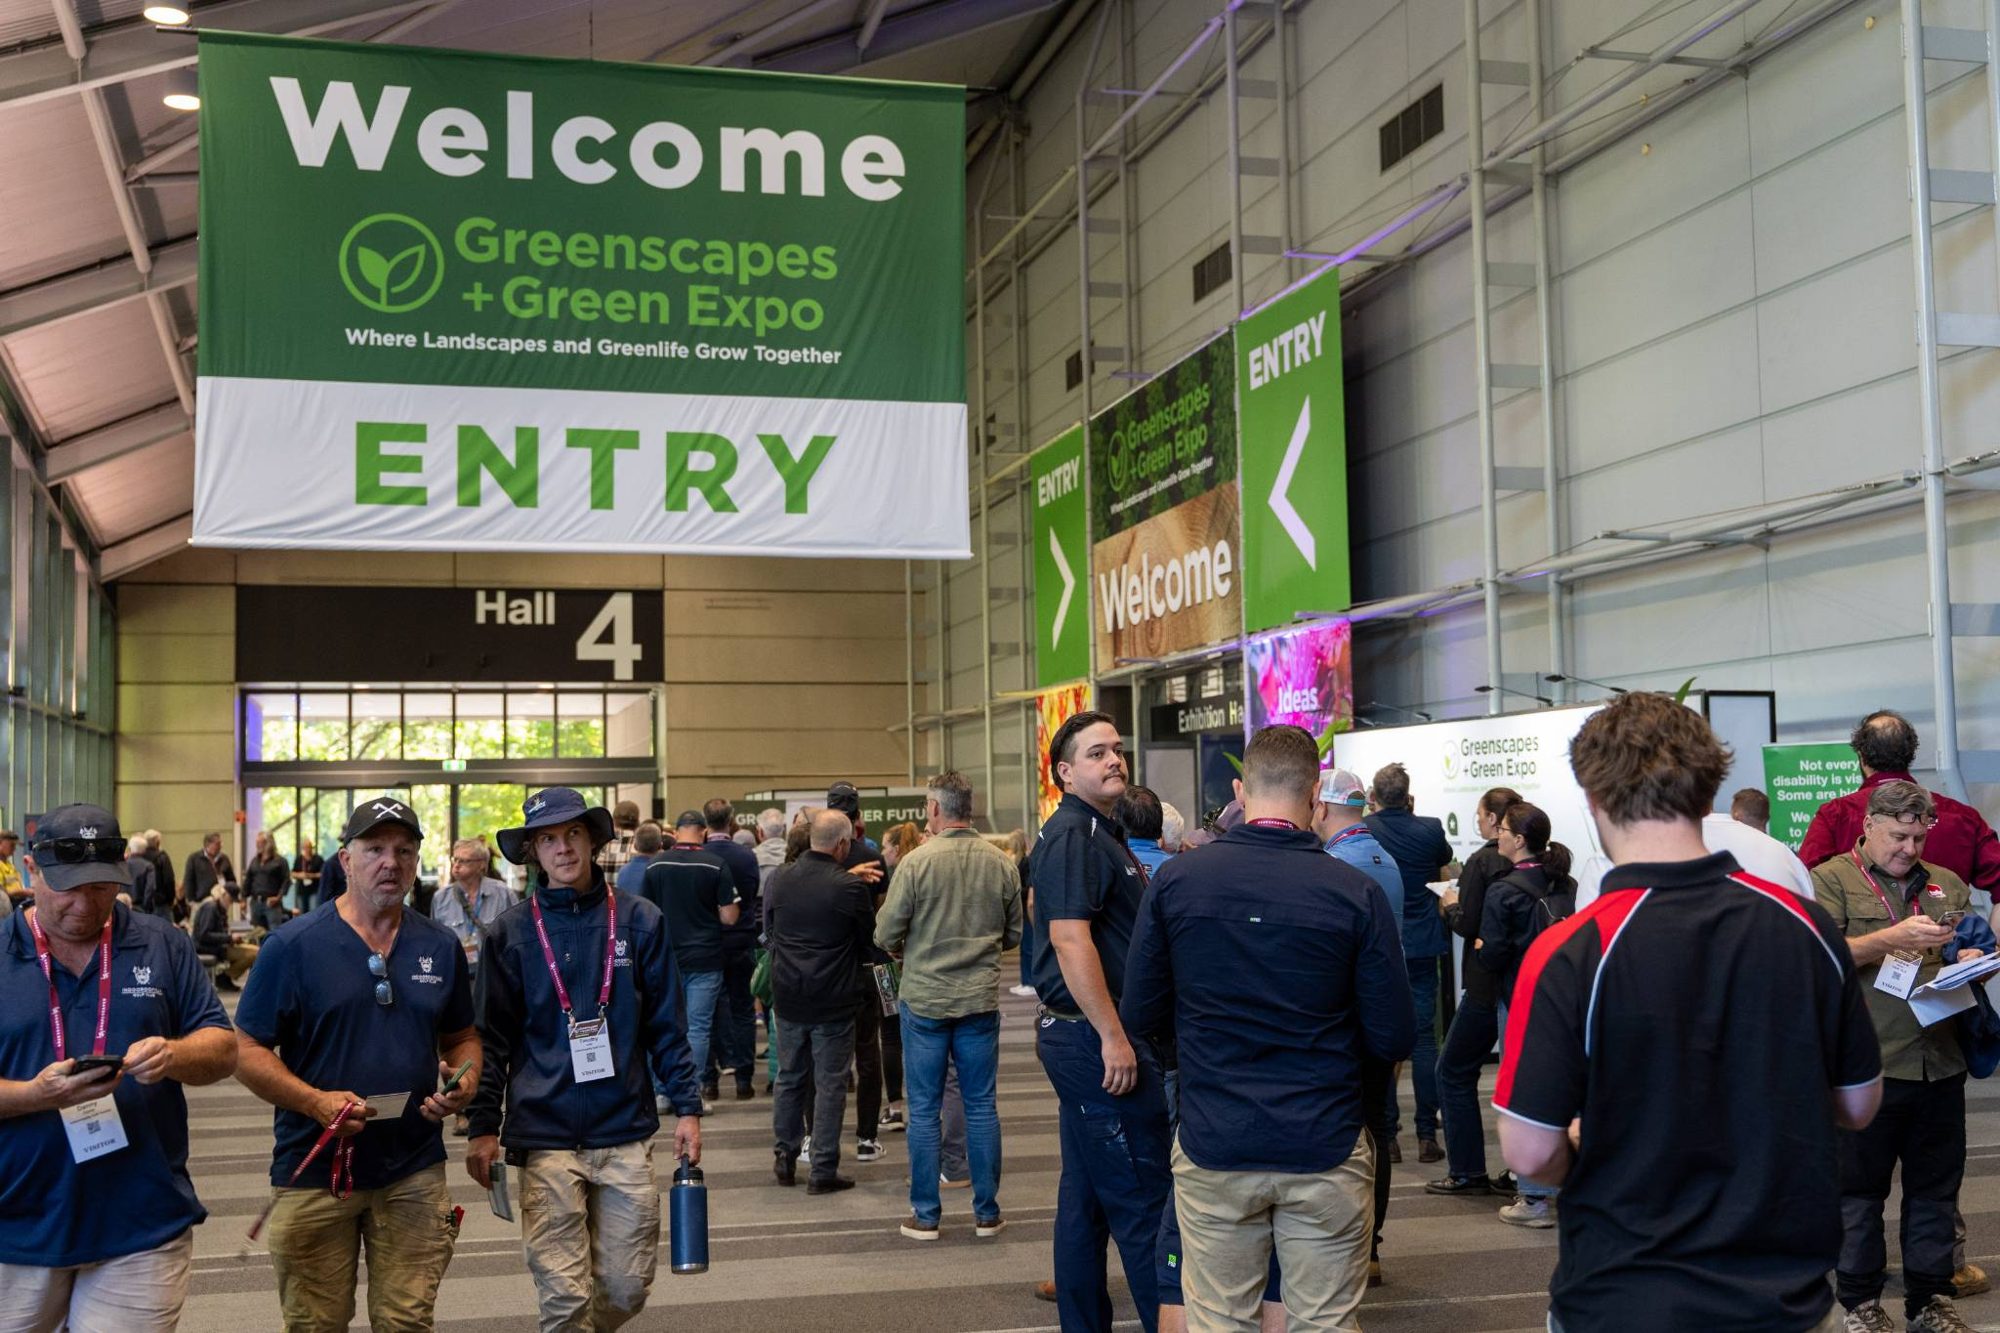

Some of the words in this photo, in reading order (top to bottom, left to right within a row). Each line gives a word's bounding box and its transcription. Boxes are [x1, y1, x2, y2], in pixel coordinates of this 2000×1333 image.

[269, 76, 906, 202] Welcome
[454, 217, 838, 285] Greenscapes
[688, 284, 824, 337] Expo
[345, 328, 417, 348] Where
[423, 331, 547, 354] Landscapes
[552, 337, 592, 354] and
[597, 338, 689, 359] Greenlife
[695, 342, 748, 361] Grow
[754, 345, 842, 365] Together
[1249, 310, 1326, 391] ENTRY
[1127, 382, 1210, 450] Greenscapes
[1175, 423, 1208, 460] Expo
[355, 421, 837, 515] ENTRY
[1037, 455, 1080, 508] ENTRY
[1100, 539, 1232, 634] Welcome
[475, 590, 555, 625] Hall
[576, 591, 642, 680] 4
[1278, 684, 1318, 714] Ideas
[1178, 704, 1225, 733] Exhibition
[1229, 700, 1244, 725] Ha
[1460, 736, 1539, 756] Greenscapes
[1506, 758, 1537, 779] Expo
[1772, 774, 1828, 787] disability
[1831, 773, 1842, 785] is
[1845, 773, 1863, 785] vis
[1800, 759, 1822, 771] Not
[1825, 760, 1860, 771] every
[1777, 789, 1813, 801] Some
[1816, 790, 1837, 800] are
[735, 813, 757, 826] GR
[864, 809, 883, 822] ER
[886, 808, 926, 821] FUTU
[1789, 827, 1802, 837] to
[1791, 811, 1810, 823] We
[581, 1067, 606, 1076] VISITOR
[83, 1138, 116, 1153] VISITOR
